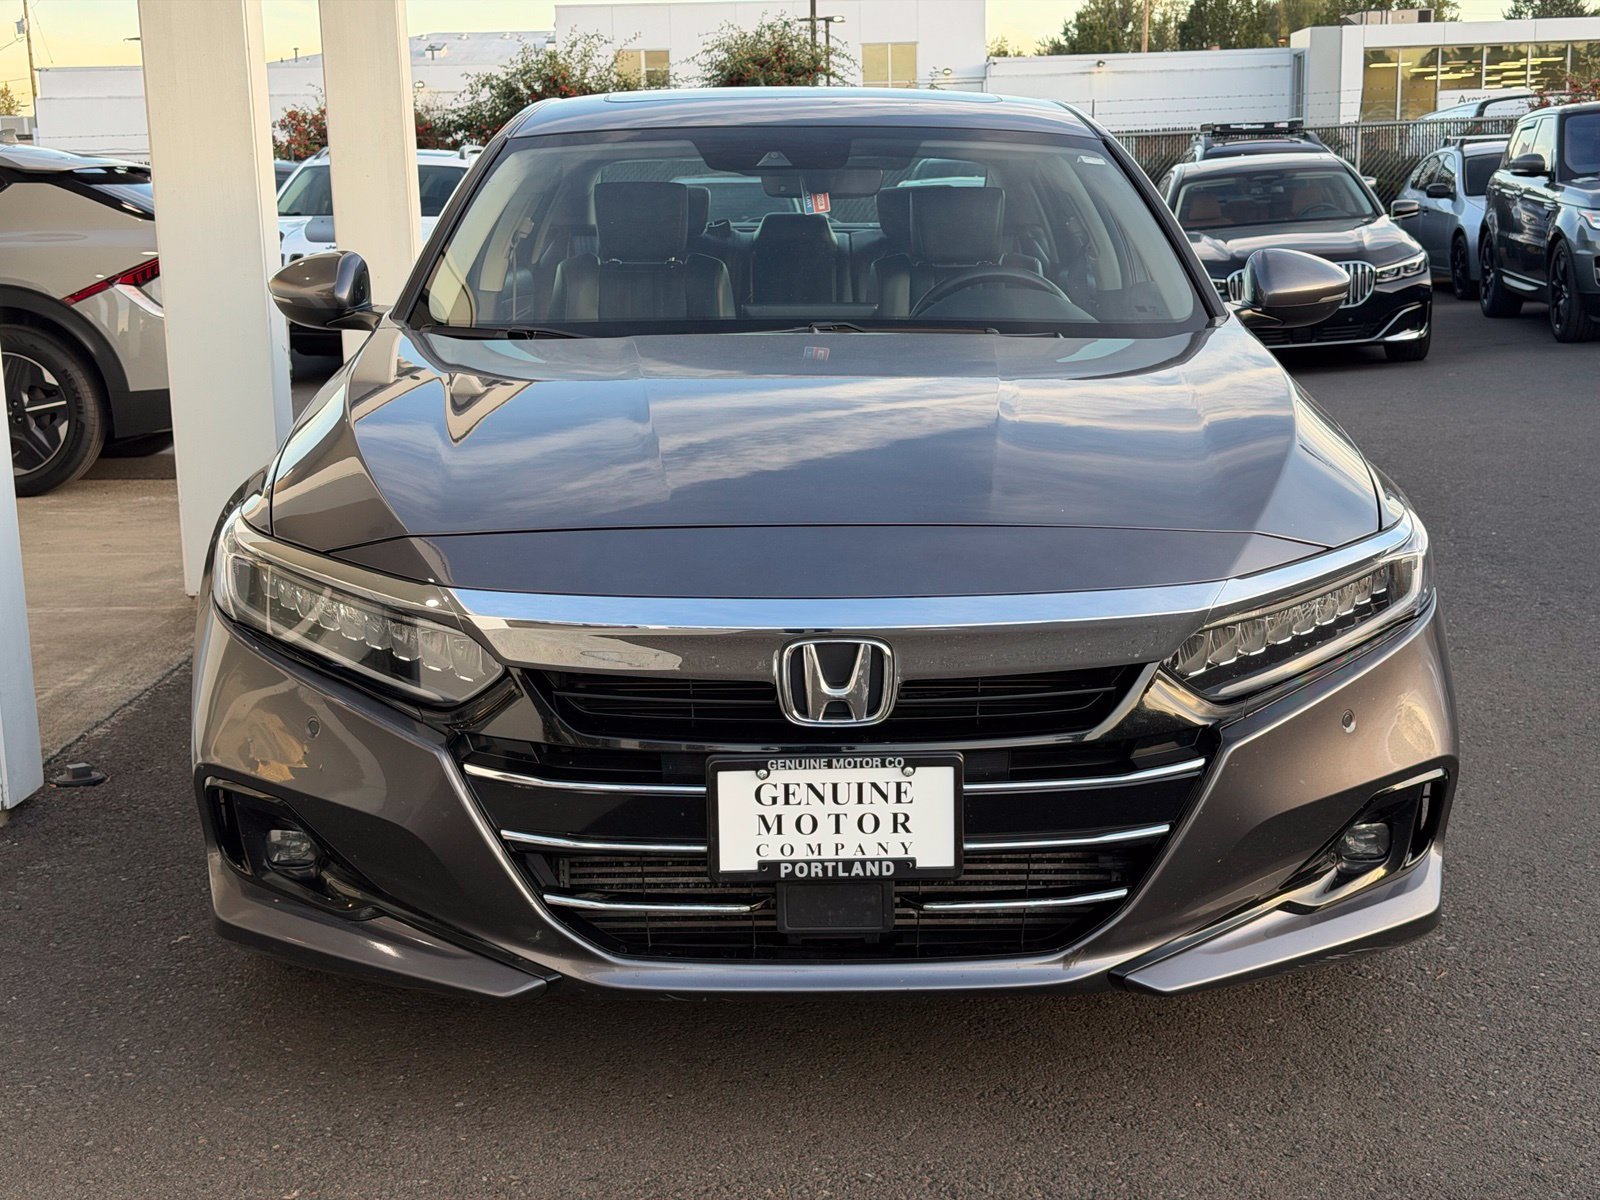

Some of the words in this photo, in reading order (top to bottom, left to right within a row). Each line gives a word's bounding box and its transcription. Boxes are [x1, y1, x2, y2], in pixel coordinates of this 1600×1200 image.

[61, 368, 84, 415] NEXEN
[767, 759, 828, 771] GENUINE
[832, 758, 881, 769] MOTOR
[885, 757, 905, 768] CO
[754, 781, 914, 807] GENUINE
[755, 812, 913, 836] MOTOR
[756, 842, 913, 857] COMPANY
[780, 861, 895, 878] PORTLAND
